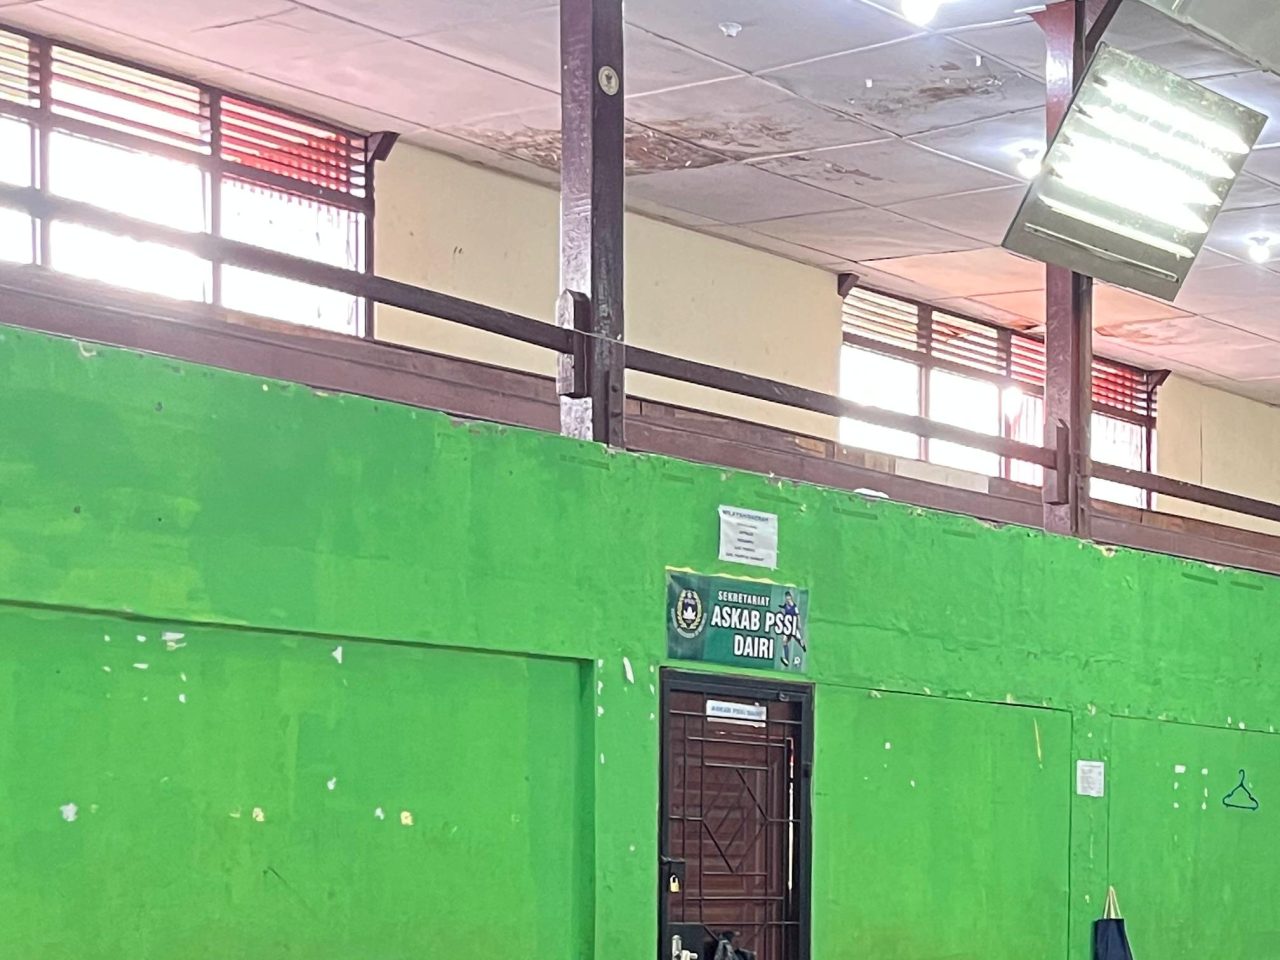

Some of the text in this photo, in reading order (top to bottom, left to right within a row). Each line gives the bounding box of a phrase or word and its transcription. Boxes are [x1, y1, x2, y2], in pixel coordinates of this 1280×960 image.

[718, 590, 770, 607] SEKRETARIAT
[711, 605, 760, 631] ASKAB
[764, 611, 797, 636] PSSI
[734, 634, 774, 659] DAIRI
